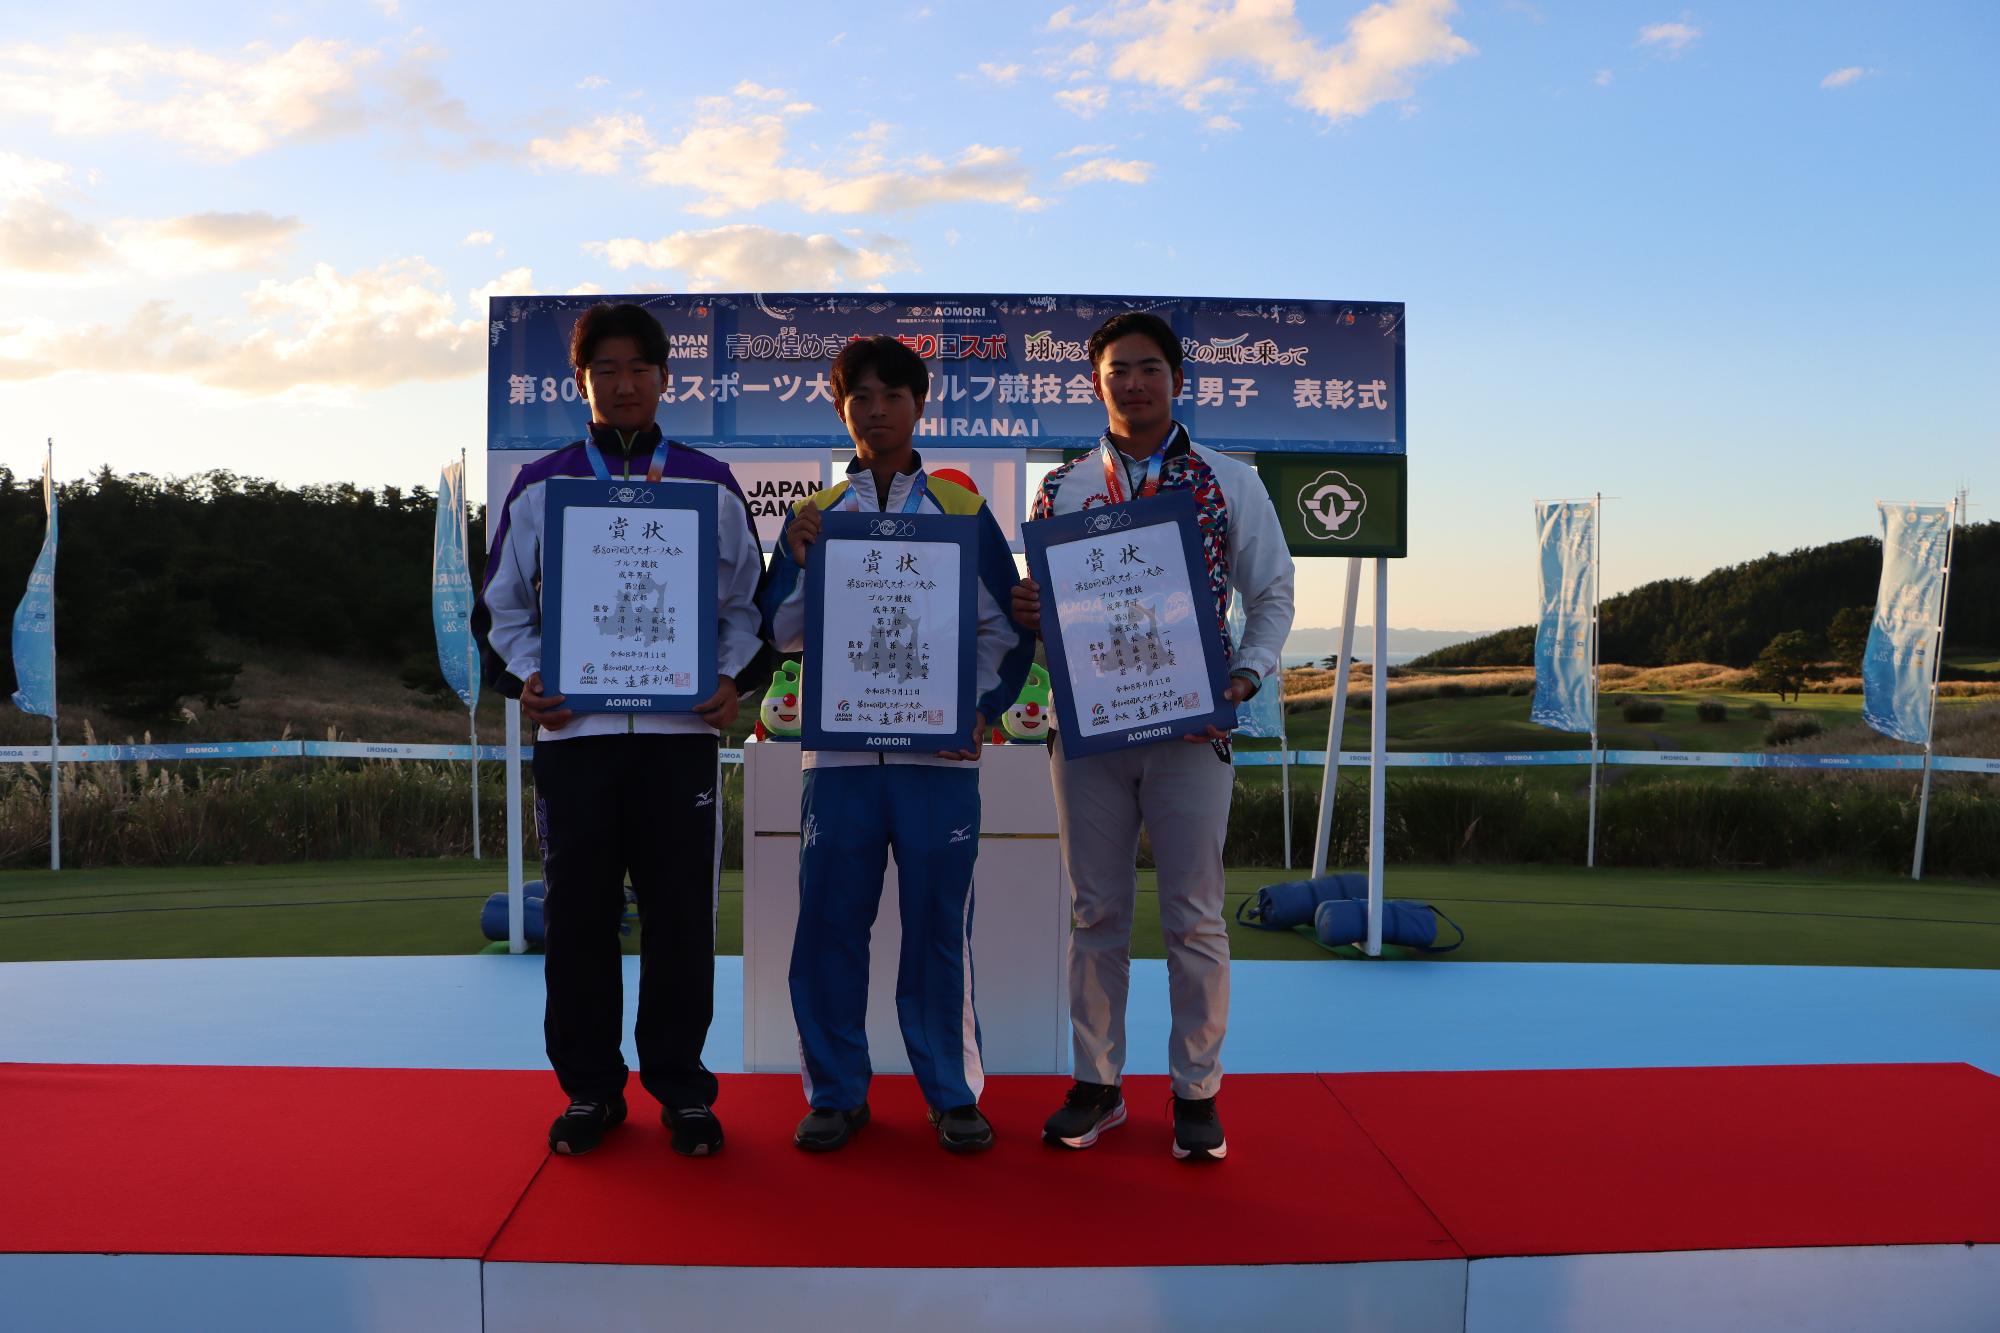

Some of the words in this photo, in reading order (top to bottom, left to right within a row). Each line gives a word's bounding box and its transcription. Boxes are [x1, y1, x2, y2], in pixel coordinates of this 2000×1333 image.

[934, 306, 986, 316] AOMORI
[668, 334, 708, 346] APAN
[667, 346, 708, 359] AMES
[1292, 378, 1388, 410] 表彰式
[914, 418, 1040, 437] HIRANAI
[747, 480, 824, 498] JAPAN
[748, 500, 796, 516] GAM
[605, 698, 652, 708] AOMORI
[866, 736, 912, 746] AOMORI
[1126, 725, 1174, 743] AOMORI
